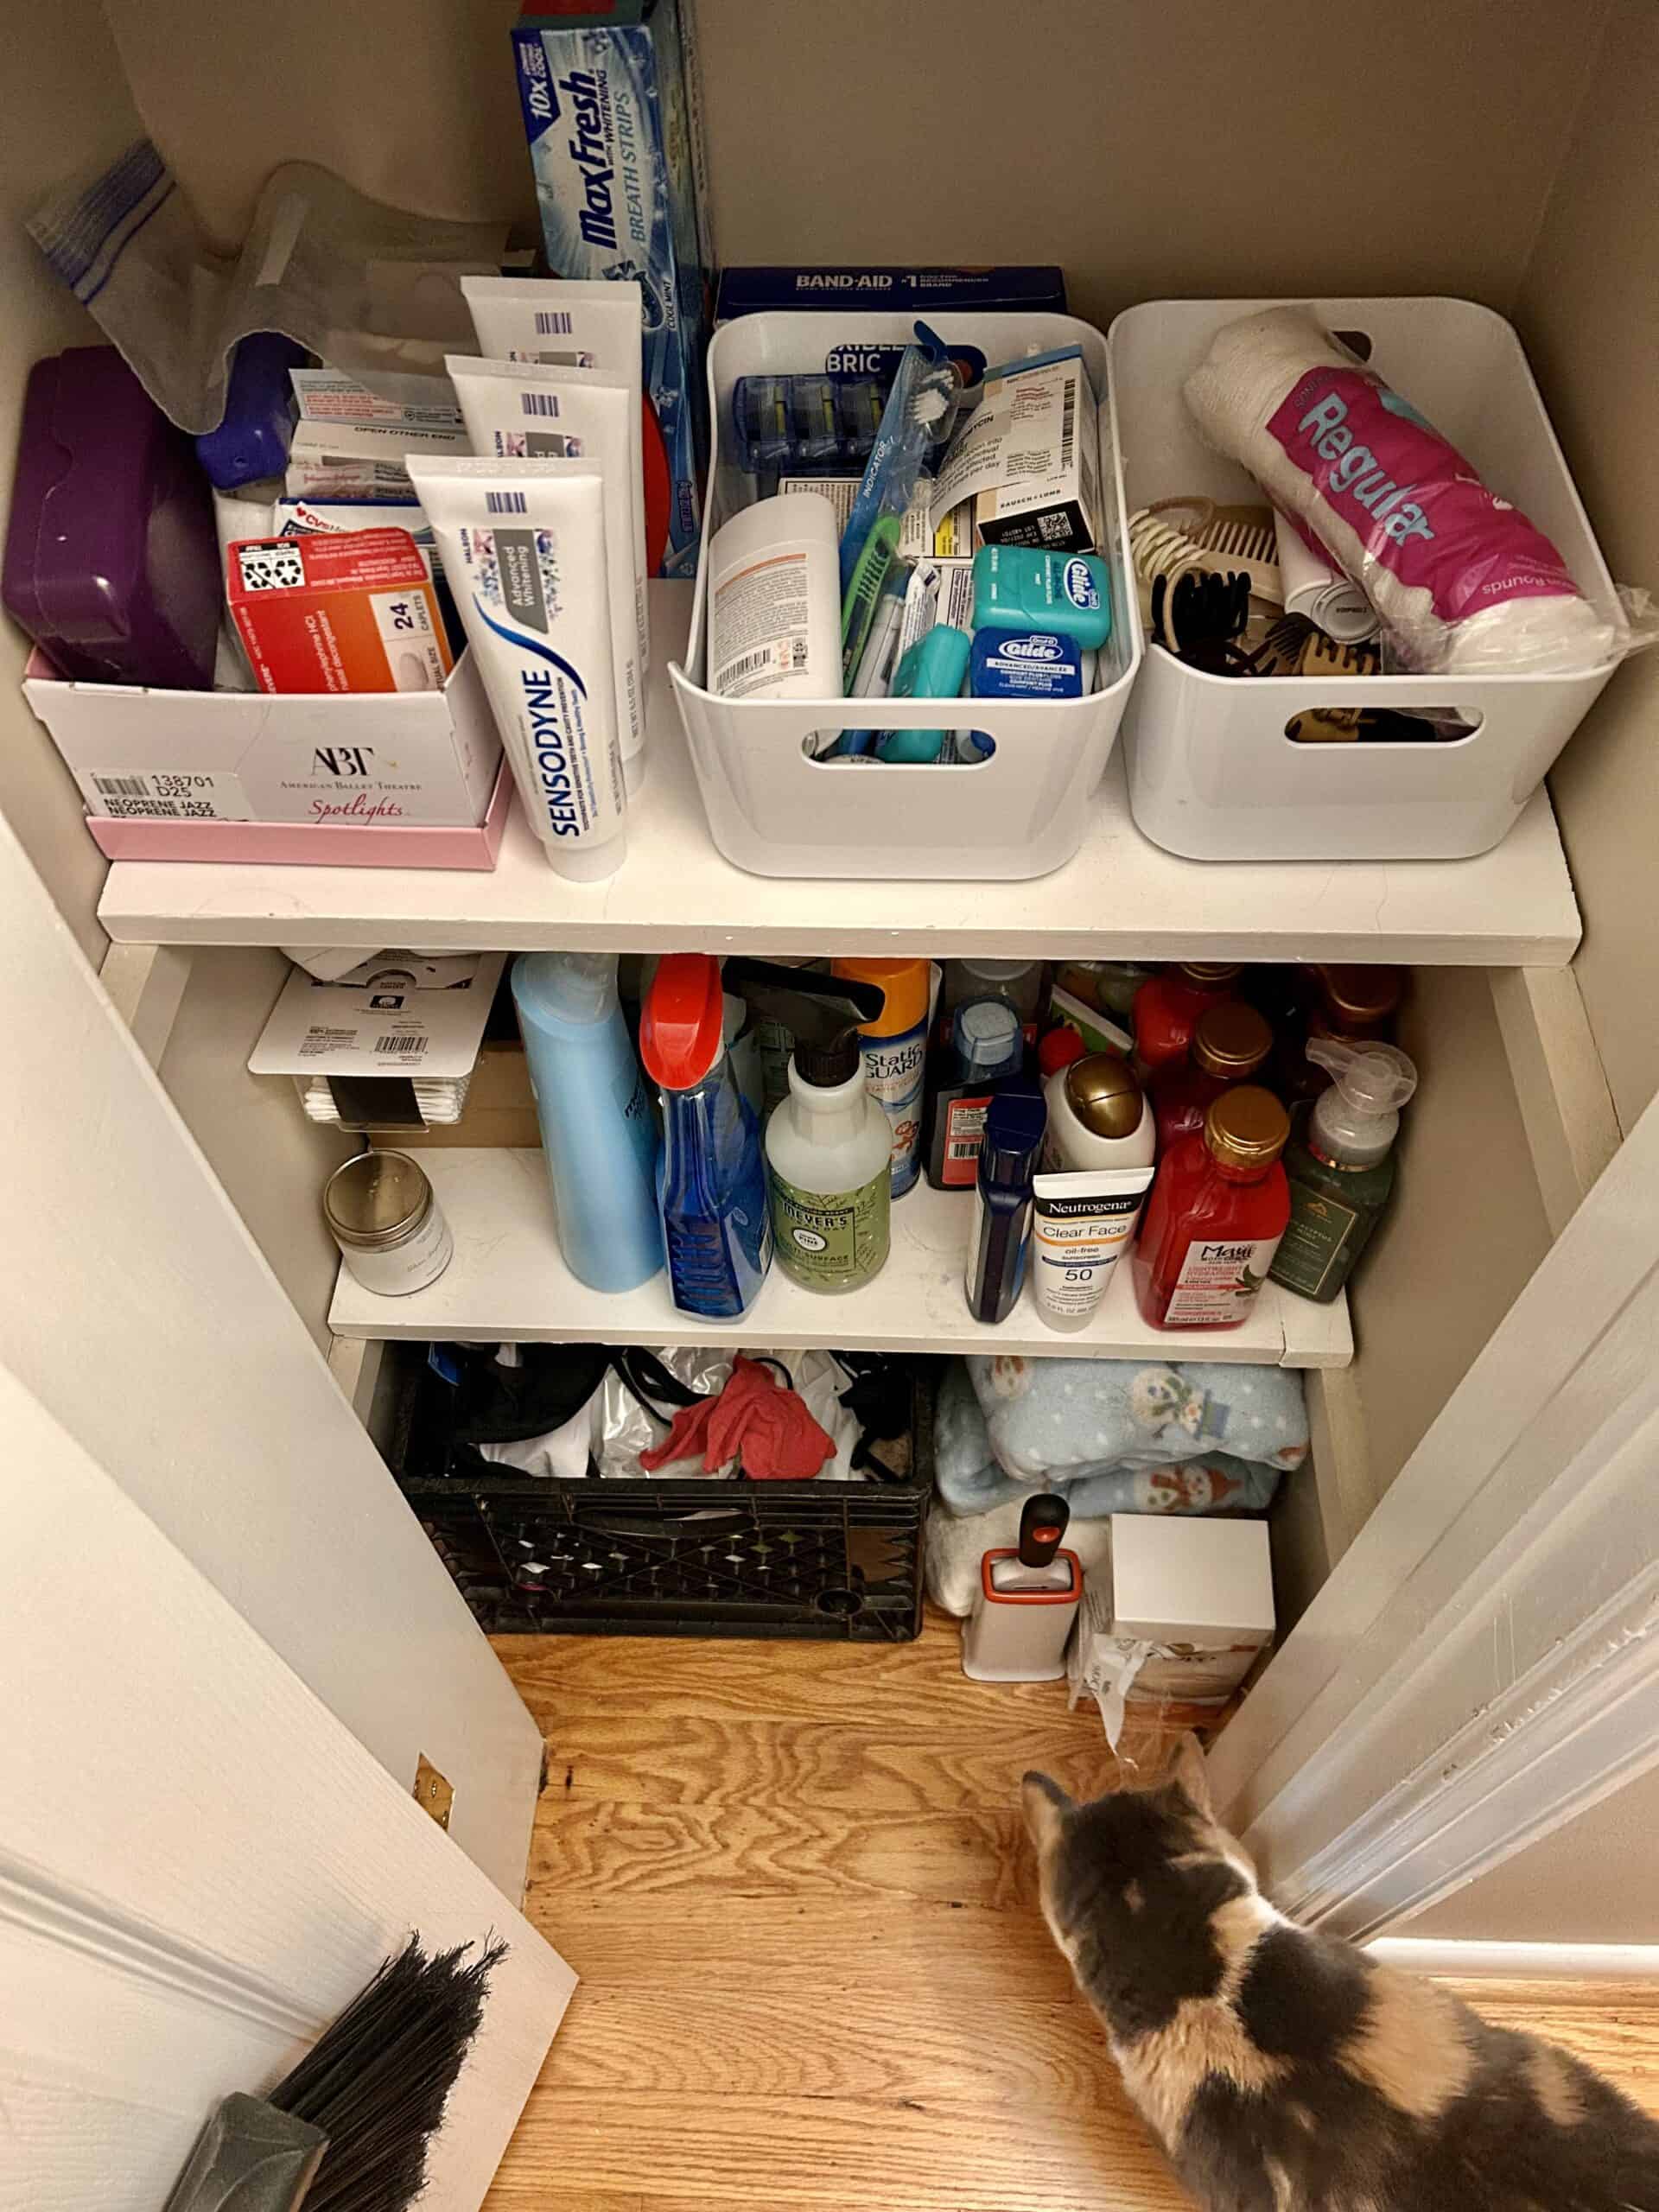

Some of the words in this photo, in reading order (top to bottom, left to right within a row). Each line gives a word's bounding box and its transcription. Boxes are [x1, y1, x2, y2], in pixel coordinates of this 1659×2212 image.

[598, 69, 614, 144] WHITENING
[617, 90, 635, 163] STRIPS
[625, 166, 646, 243] BREATH
[664, 281, 673, 304] MINT
[796, 275, 893, 288] BAND-AID
[666, 304, 676, 329] COOL
[354, 426, 388, 435] OPEN
[389, 429, 429, 437] OTHER
[861, 439, 887, 499] INDICATOR
[1299, 393, 1436, 547] Regular
[1000, 497, 1033, 509] BAUSCH
[306, 513, 331, 530] CVS
[459, 528, 474, 564] HALEON
[504, 545, 522, 607] Advanced
[516, 545, 536, 608] Whitening
[1071, 563, 1090, 605] Glide
[391, 603, 413, 630] 24
[420, 594, 430, 632] CAPLETS
[317, 610, 342, 668] decongestant
[1006, 643, 1056, 659] Glide
[427, 647, 438, 664] SIZE
[336, 669, 349, 691] nasal
[556, 677, 568, 714] PREVENTION
[522, 668, 580, 837] SENSODYNE
[569, 747, 577, 763] TEETH
[151, 774, 214, 788] 138701
[156, 786, 192, 798] D25
[104, 798, 176, 809] NEOPRENE
[180, 800, 213, 810] JAZZ
[108, 806, 181, 817] NEOPRENE
[183, 808, 217, 817] JAZZ
[308, 793, 404, 824] Spotlights
[865, 1043, 920, 1068] Static
[865, 1050, 923, 1079] GUARD
[1049, 1200, 1128, 1214] Neutrogena
[1043, 1225, 1082, 1238] Clear
[1088, 1224, 1128, 1236] Face
[1202, 1244, 1252, 1258] Maui
[1065, 1268, 1093, 1281] 50
